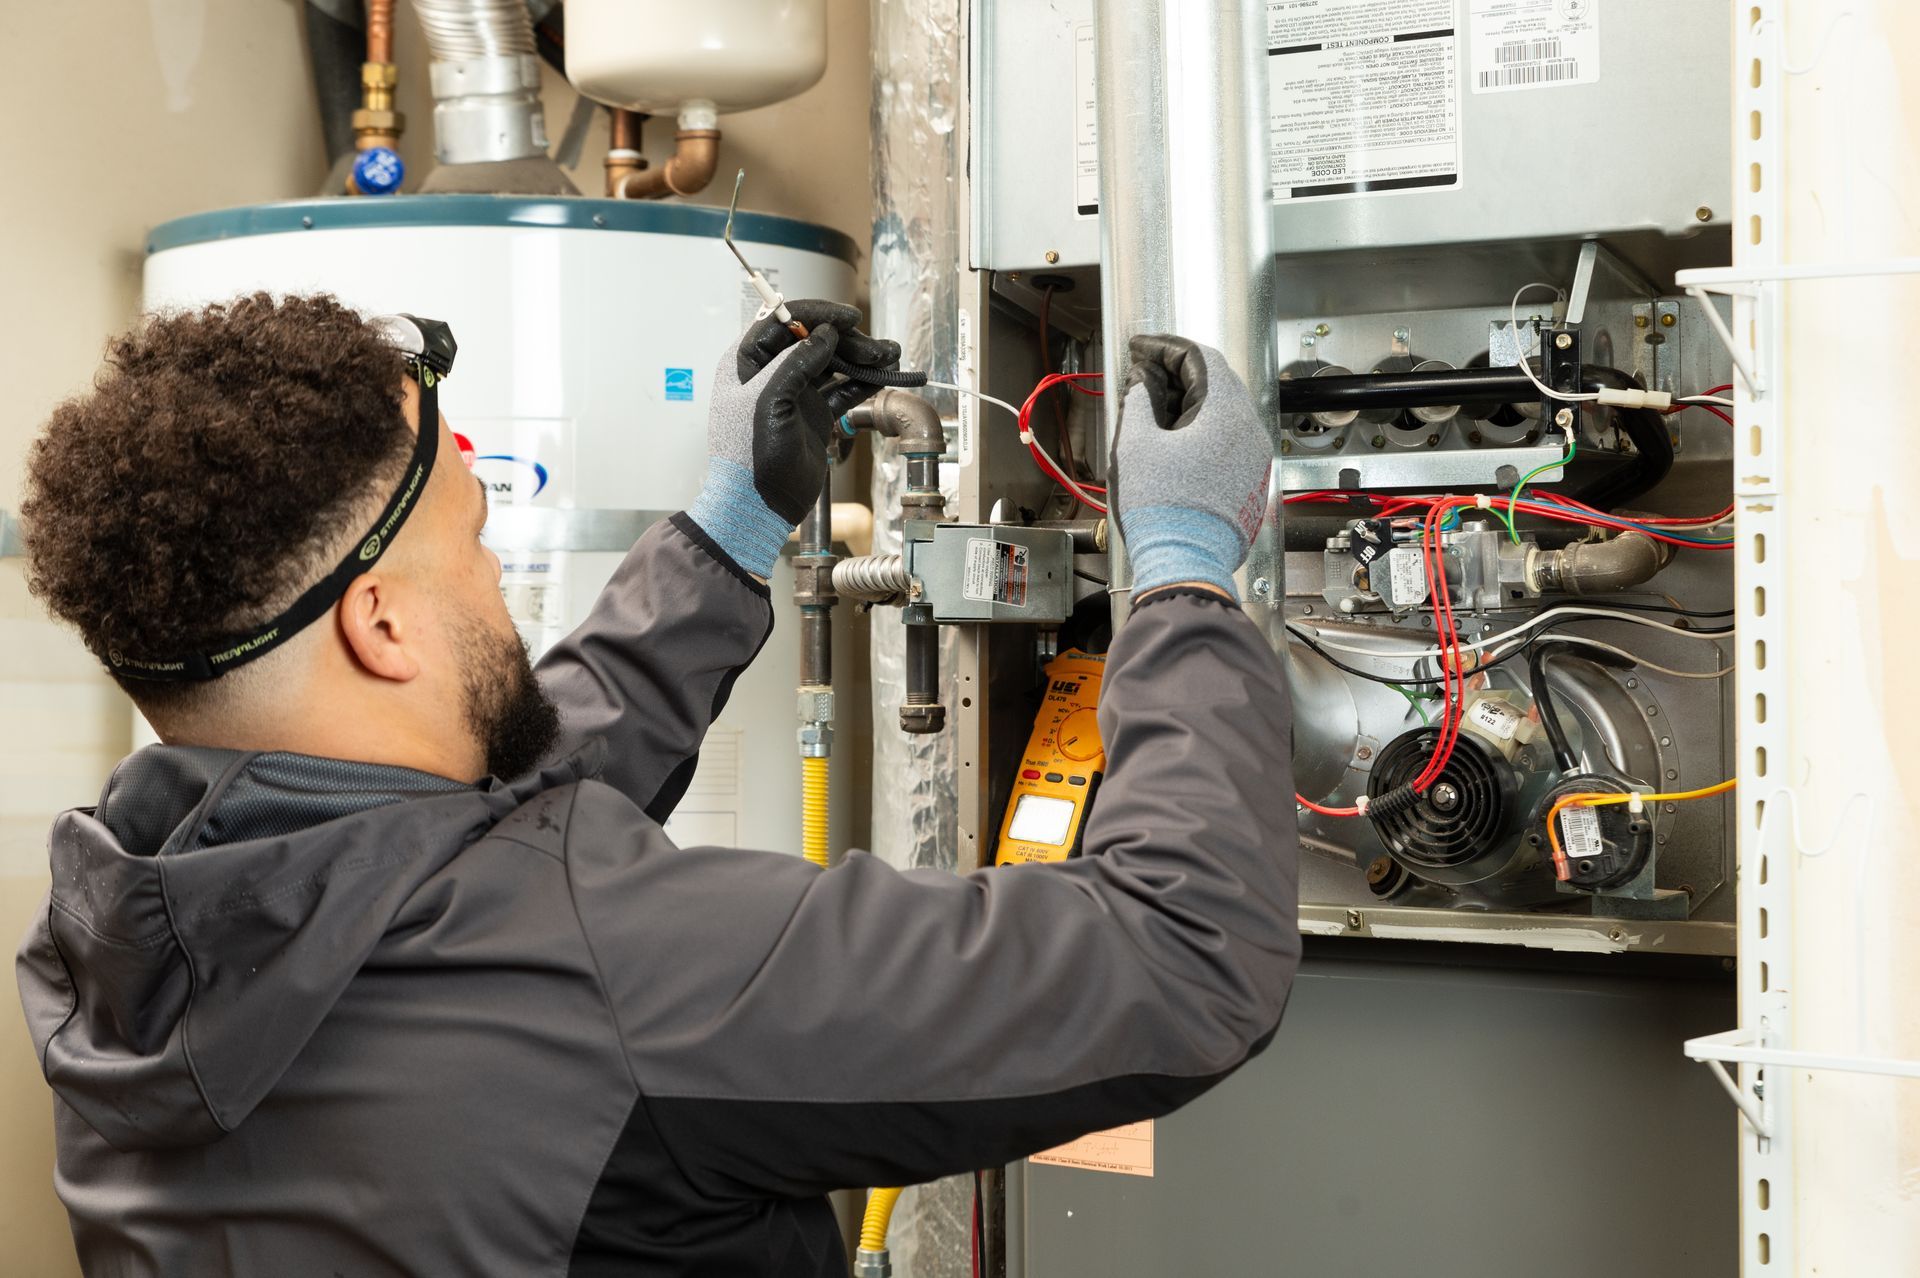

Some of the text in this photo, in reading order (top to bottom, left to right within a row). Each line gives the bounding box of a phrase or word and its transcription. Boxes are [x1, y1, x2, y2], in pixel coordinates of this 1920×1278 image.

[1326, 35, 1389, 49] COMPONENT TEST
[1311, 168, 1330, 176] CODE
[378, 463, 425, 539] STREAMLIGHT
[1360, 545, 1376, 564] OFF
[1480, 714, 1496, 726] #122
